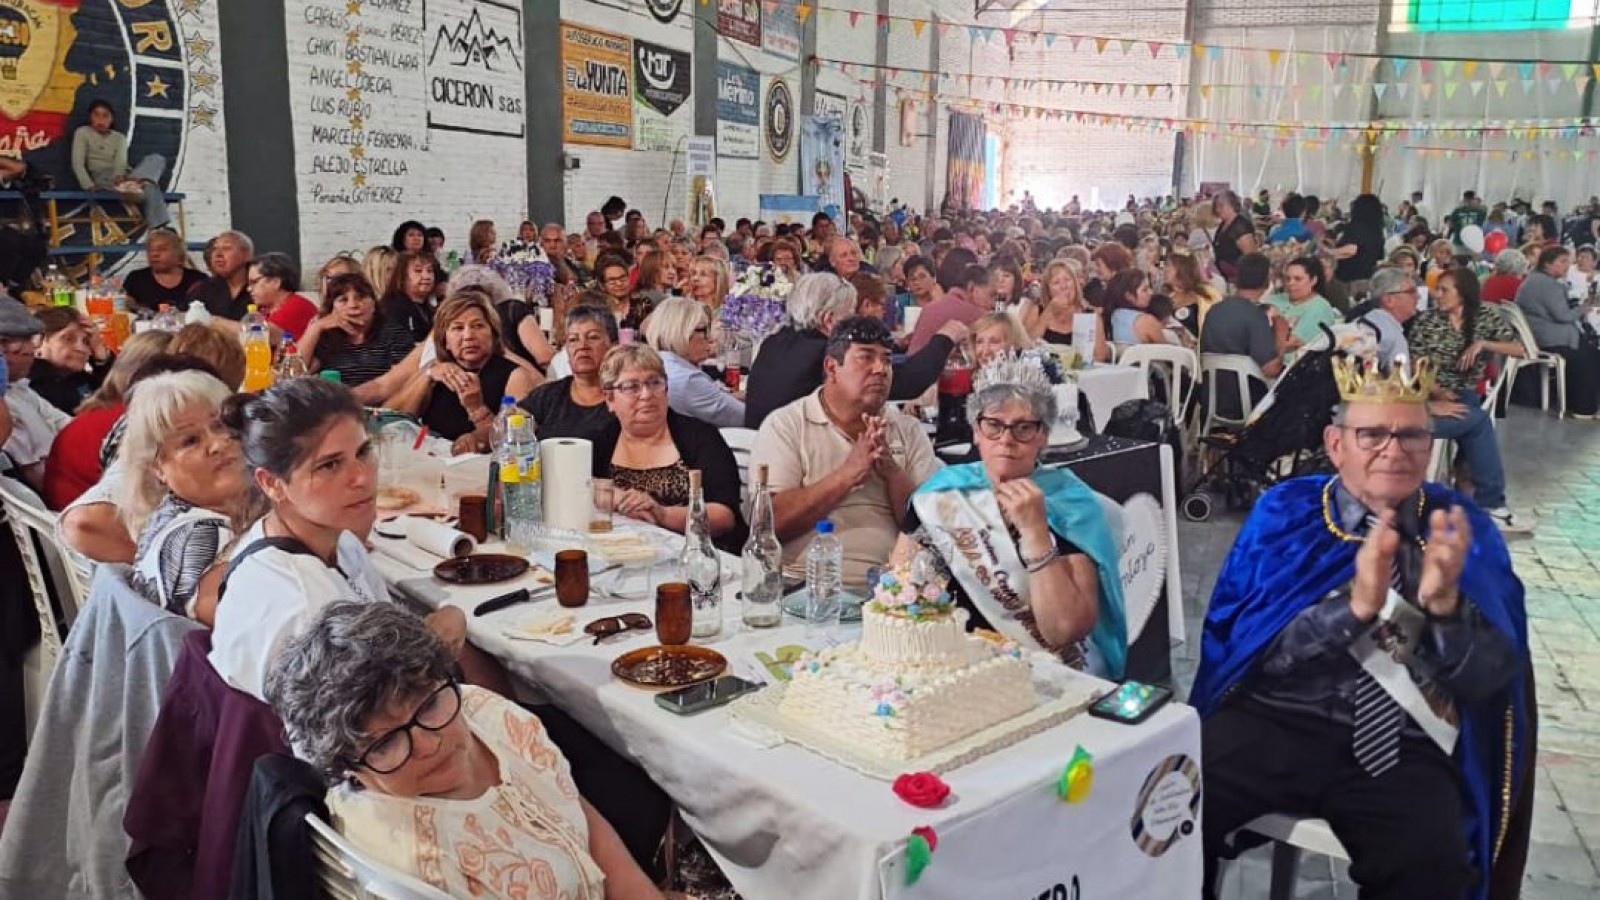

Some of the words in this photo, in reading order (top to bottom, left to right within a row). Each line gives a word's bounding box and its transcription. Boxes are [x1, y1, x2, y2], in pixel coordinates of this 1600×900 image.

[304, 5, 350, 31] CARLOS
[390, 22, 419, 44] PEREZ
[392, 53, 419, 70] LARA
[309, 64, 352, 89] ANGEL
[584, 59, 629, 97] YUNTA
[310, 95, 336, 115] LUIS
[338, 98, 372, 119] RUBIO
[432, 76, 494, 110] CICERON
[498, 95, 523, 114] sas
[312, 126, 365, 147] MARCELO
[312, 155, 350, 175] ALEJO
[354, 157, 409, 177] ESTRELLA
